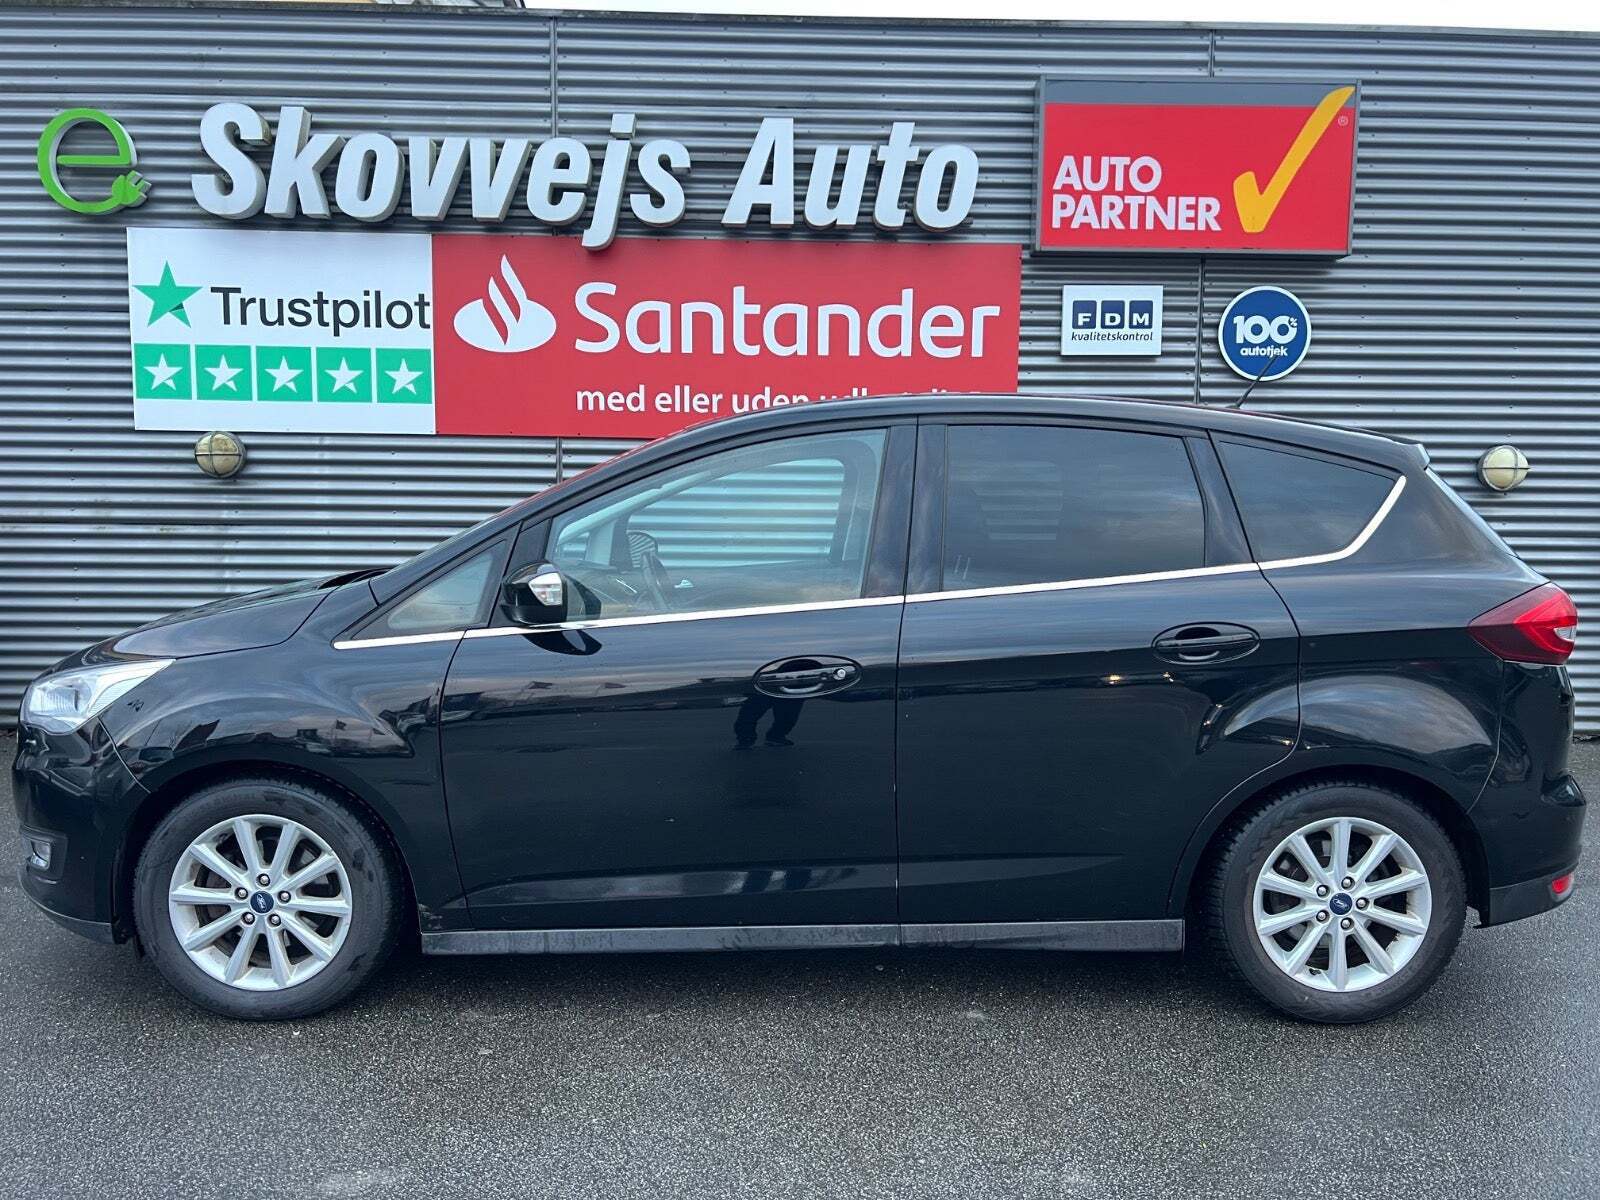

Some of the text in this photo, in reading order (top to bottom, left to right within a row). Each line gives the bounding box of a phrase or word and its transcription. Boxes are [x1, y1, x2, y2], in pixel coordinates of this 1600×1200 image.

[191, 102, 981, 250] Skovvejs Auto
[1052, 155, 1162, 192] AUTO
[1051, 194, 1222, 231] PARTNER
[210, 285, 431, 337] Trustpilot
[574, 281, 1000, 358] Santander
[1071, 331, 1154, 342] kvalitetskontrol
[1240, 345, 1288, 358] autotjek
[576, 384, 646, 412] med
[654, 385, 723, 414] eller
